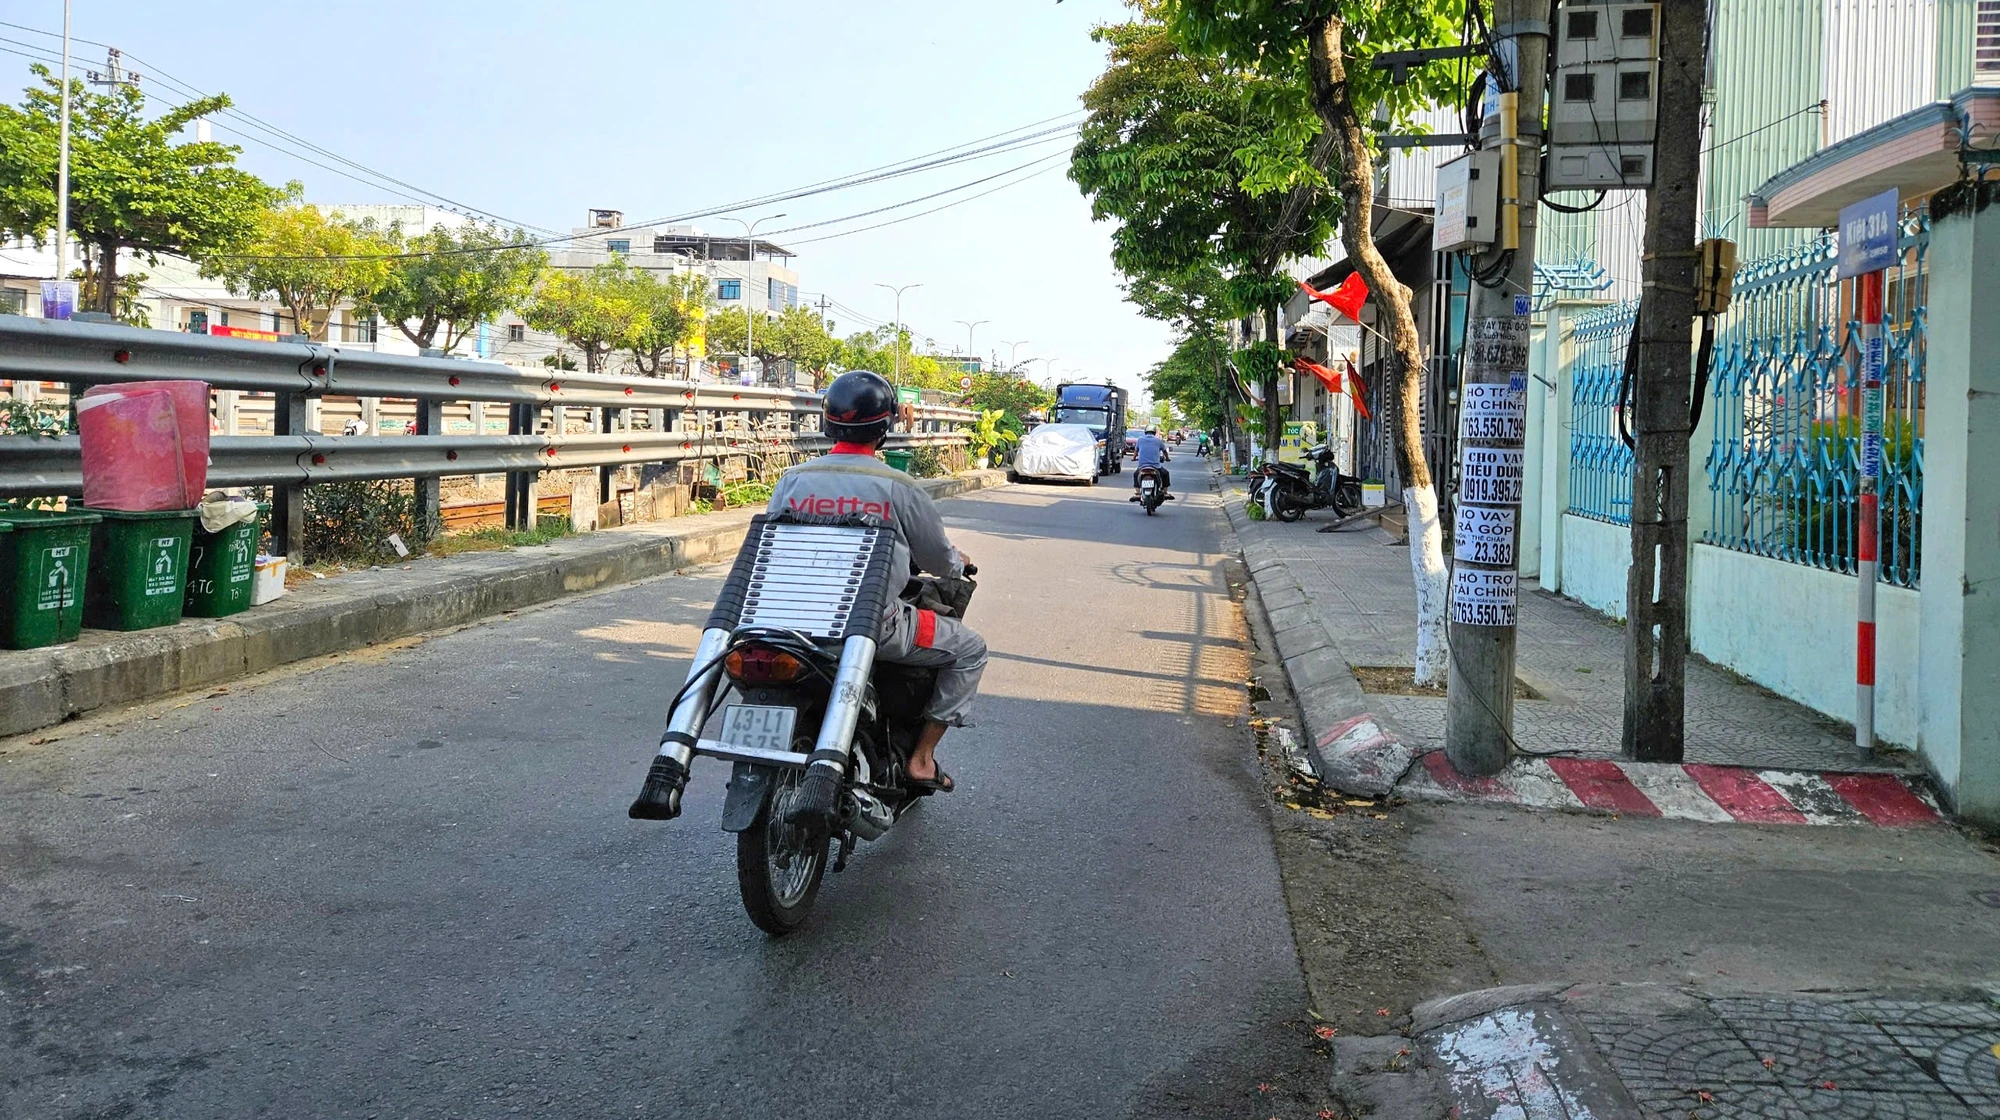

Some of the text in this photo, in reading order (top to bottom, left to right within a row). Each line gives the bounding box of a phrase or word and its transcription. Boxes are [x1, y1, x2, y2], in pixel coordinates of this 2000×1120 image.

[1867, 211, 1888, 239] 314
[1469, 452, 1497, 463] CHO
[1466, 462, 1492, 477] TIÊU
[789, 493, 890, 521] viettel
[1478, 524, 1512, 536] GÓP
[1482, 574, 1514, 587] TRỢ
[1454, 583, 1516, 597] TÀI CHÍNH
[732, 708, 784, 733] 43-L1
